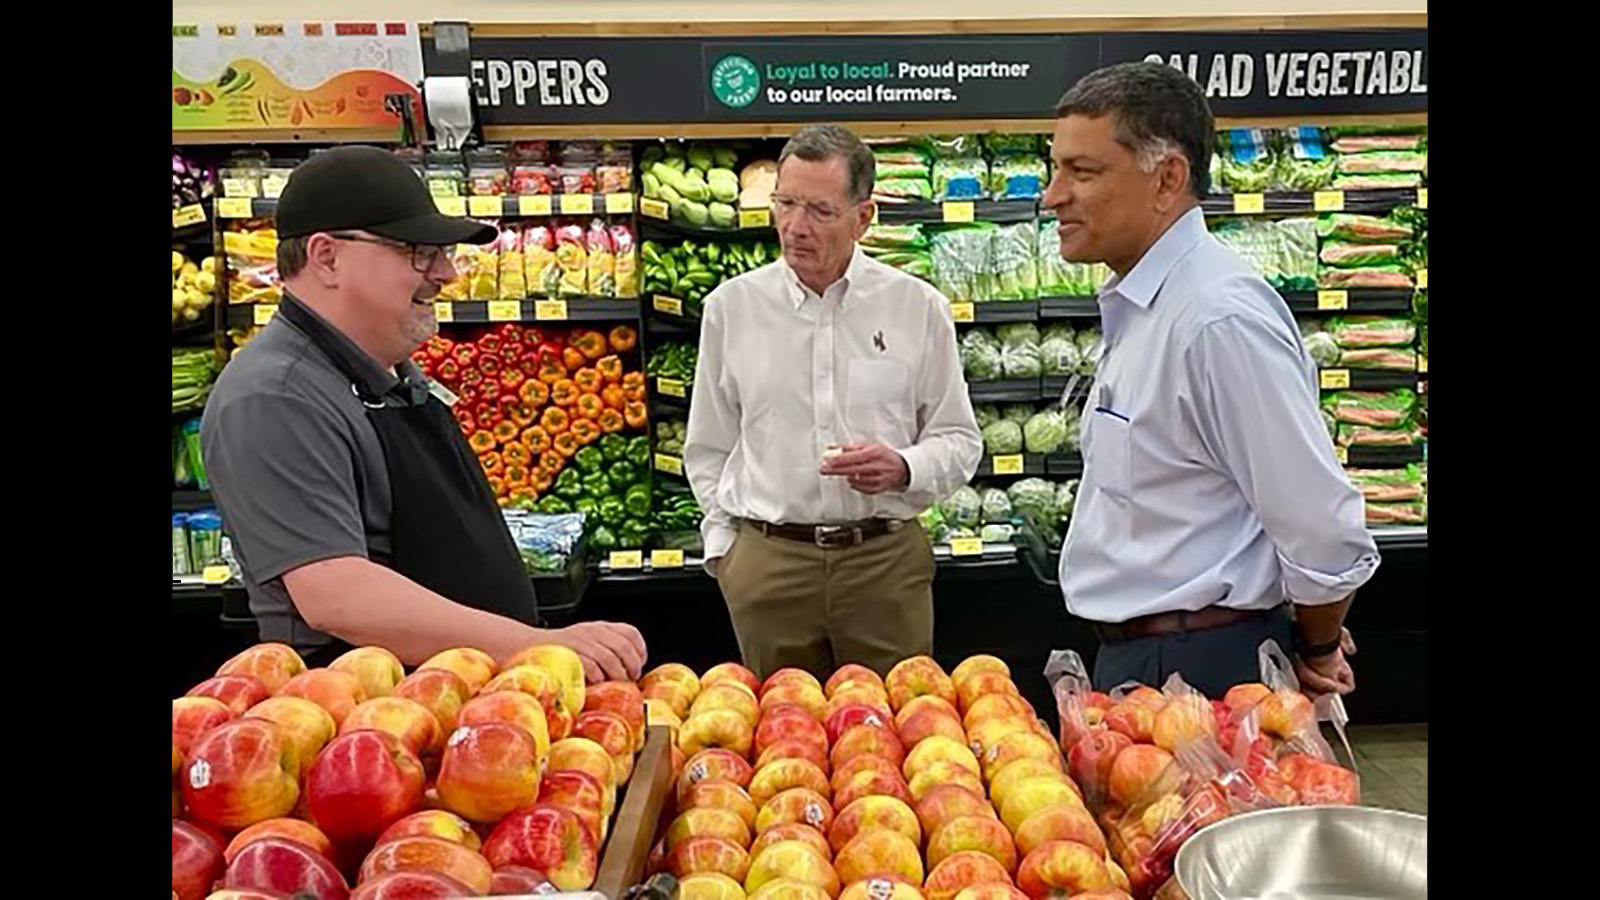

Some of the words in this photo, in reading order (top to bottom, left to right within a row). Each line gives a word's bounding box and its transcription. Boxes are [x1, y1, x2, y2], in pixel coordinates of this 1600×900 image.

[766, 63, 816, 84] Loyal
[819, 63, 840, 79] to
[843, 62, 894, 79] local.
[898, 61, 954, 79] Proud
[957, 61, 1029, 83] partner
[767, 86, 787, 103] to
[790, 88, 823, 103] our
[826, 85, 872, 102] local
[875, 84, 957, 102] farmers.
